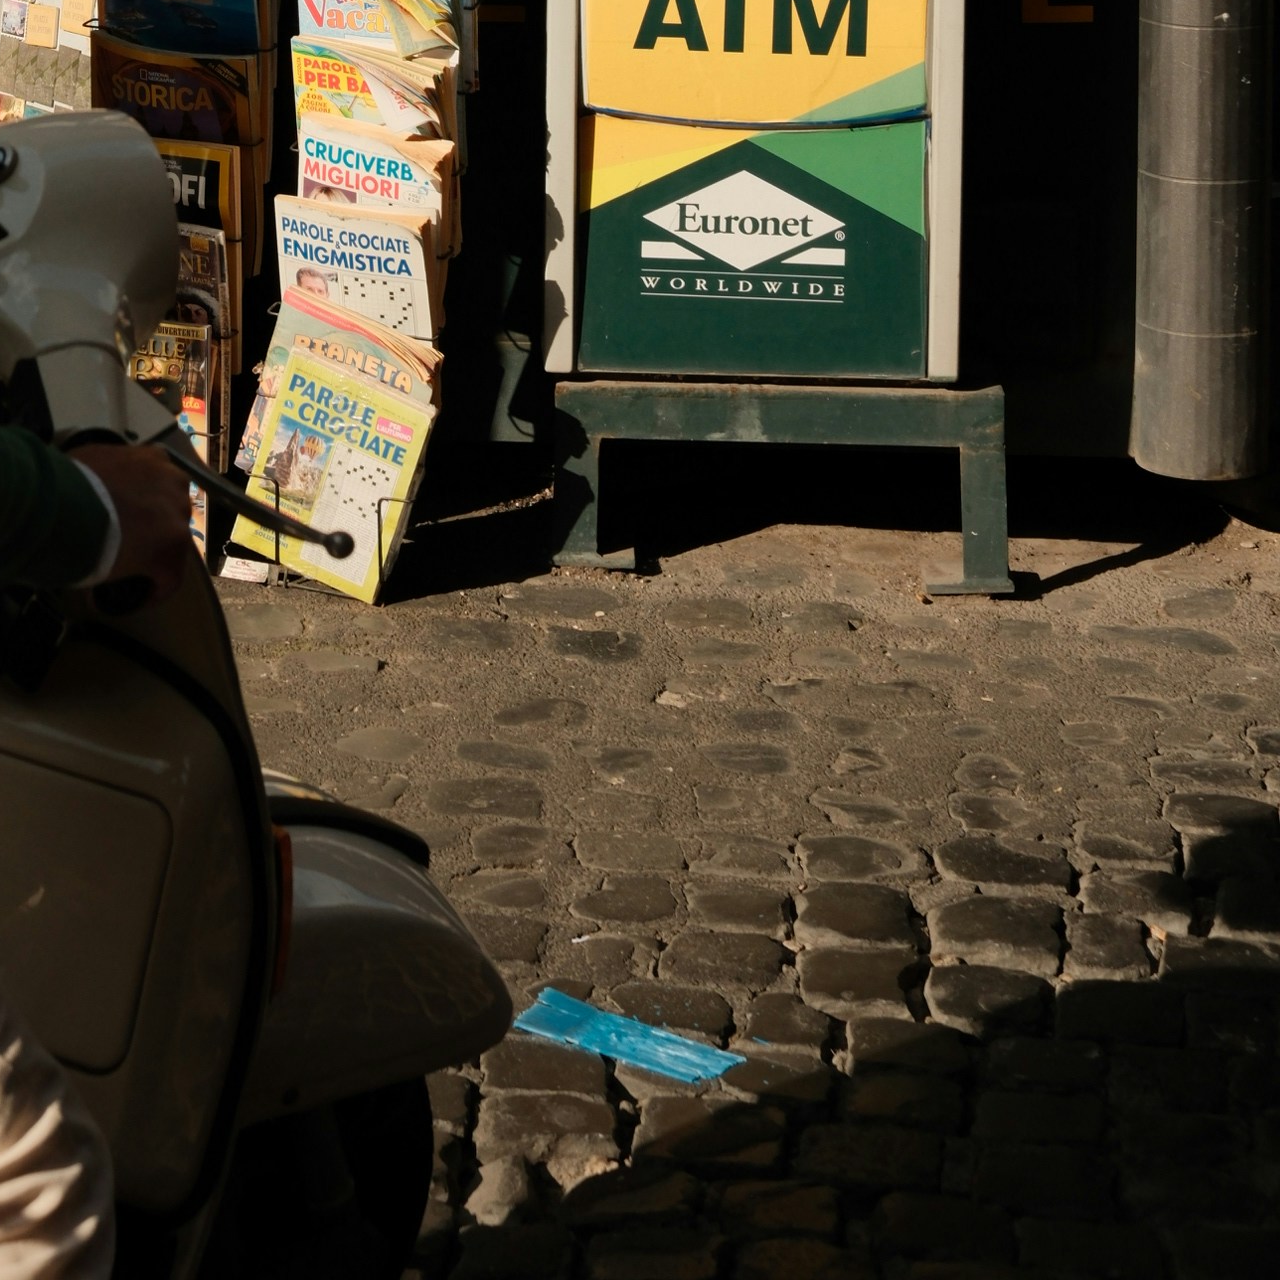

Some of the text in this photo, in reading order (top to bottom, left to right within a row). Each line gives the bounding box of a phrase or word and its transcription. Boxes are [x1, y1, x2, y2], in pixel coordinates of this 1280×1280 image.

[304, 58, 357, 76] PAROLE
[304, 70, 340, 90] PER
[112, 72, 214, 112] STORICA
[302, 100, 328, 108] PAGINE
[306, 92, 323, 100] 108
[306, 104, 330, 114] COLORI
[304, 158, 400, 200] MIGLIORI
[282, 216, 410, 254] PAROLE CROCIATE
[674, 201, 814, 239] Euronet
[283, 238, 412, 276] ENIGMISTICA
[335, 242, 340, 250] &
[640, 276, 845, 298] WORLDWIDE
[294, 334, 412, 395] PIANETA
[288, 374, 376, 428] PAROLE
[298, 402, 407, 466] CROCIATE
[389, 422, 402, 430] PER
